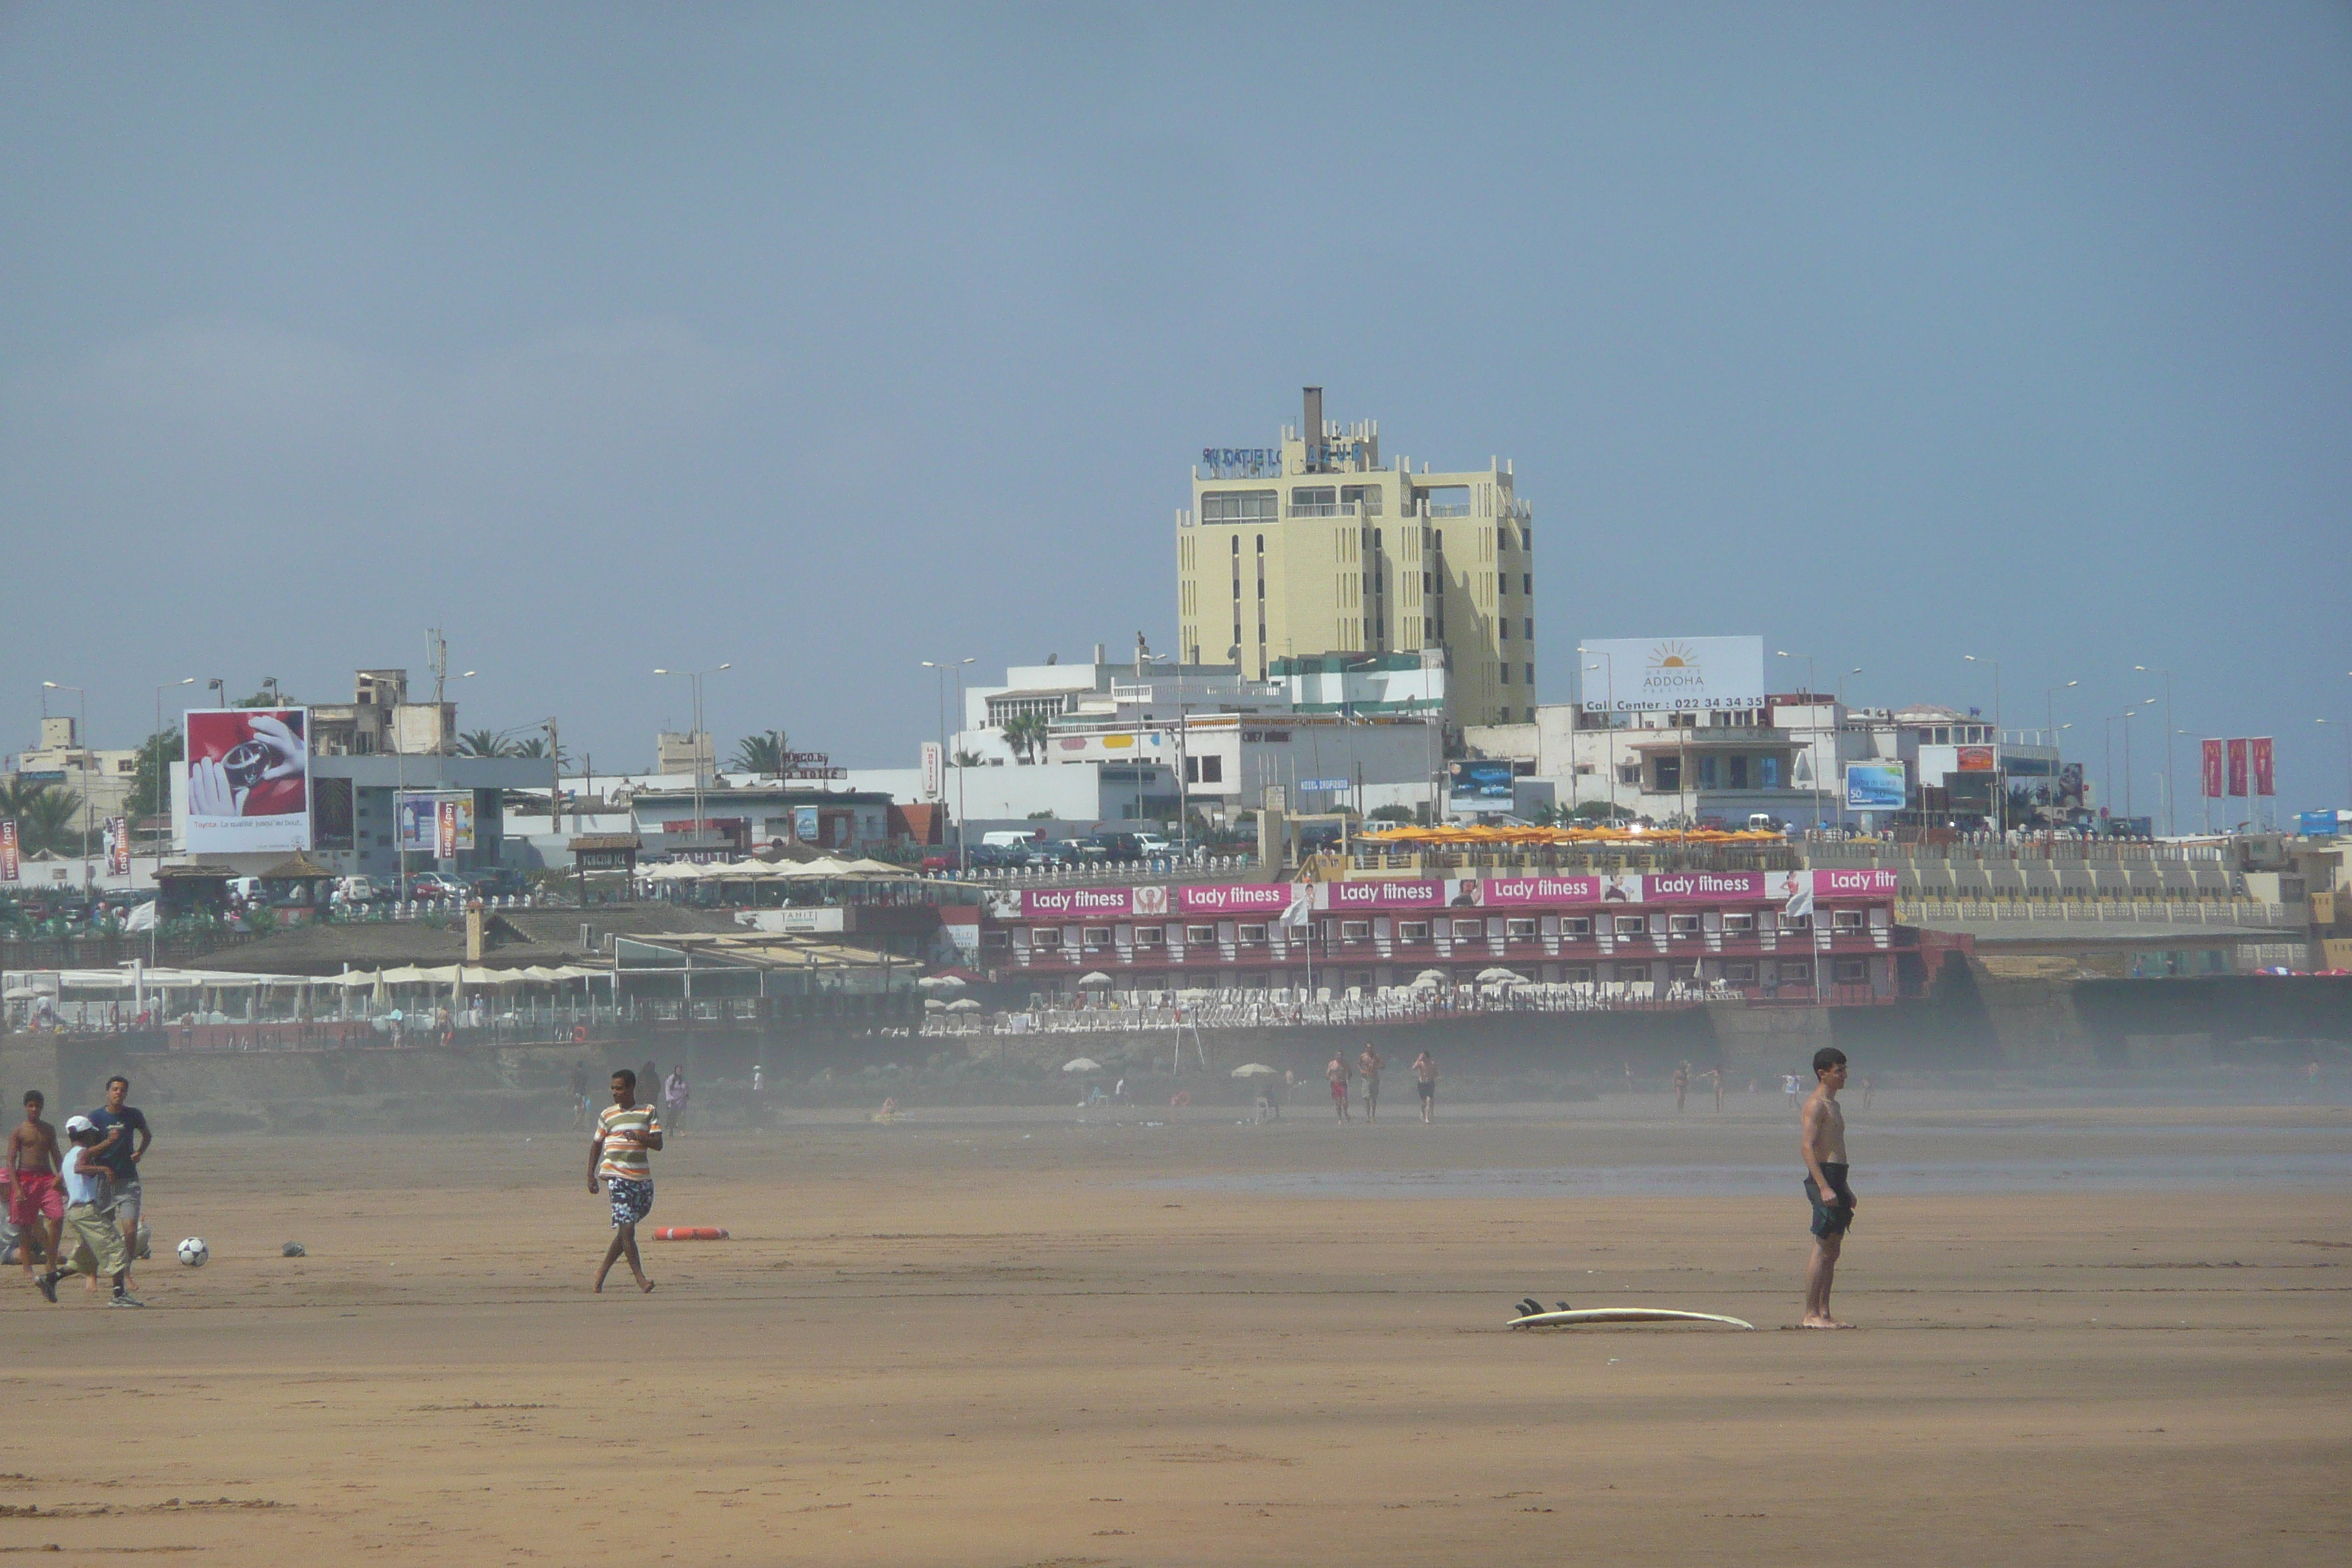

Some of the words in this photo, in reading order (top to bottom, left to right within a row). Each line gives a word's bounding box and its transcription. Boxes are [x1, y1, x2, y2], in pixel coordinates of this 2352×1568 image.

[1643, 676, 1704, 687] ADDOHA
[1617, 700, 1661, 710] Center
[1675, 698, 1700, 708] 022
[1705, 698, 1719, 707] 34
[1726, 697, 1742, 706] 34
[1746, 697, 1763, 706] 35
[1850, 790, 1862, 799] 50
[444, 803, 454, 826] Lady
[3, 822, 13, 845] Lady
[445, 828, 453, 856] fitness
[5, 848, 15, 878] fitness
[118, 851, 128, 875] Lady
[671, 852, 729, 863] TAHITI
[1495, 880, 1534, 900] Lady
[1538, 880, 1588, 895] fitness
[1655, 875, 1695, 895] Lady
[1699, 875, 1749, 892] fitness
[1831, 872, 1871, 891] Lady
[1033, 892, 1071, 911] Lady
[1075, 891, 1124, 907] fitness
[1188, 889, 1226, 907] Lady
[1230, 887, 1280, 902] fitness
[1341, 884, 1379, 902] Lady
[1383, 883, 1433, 900] fitness
[781, 911, 818, 923] TAHITI
